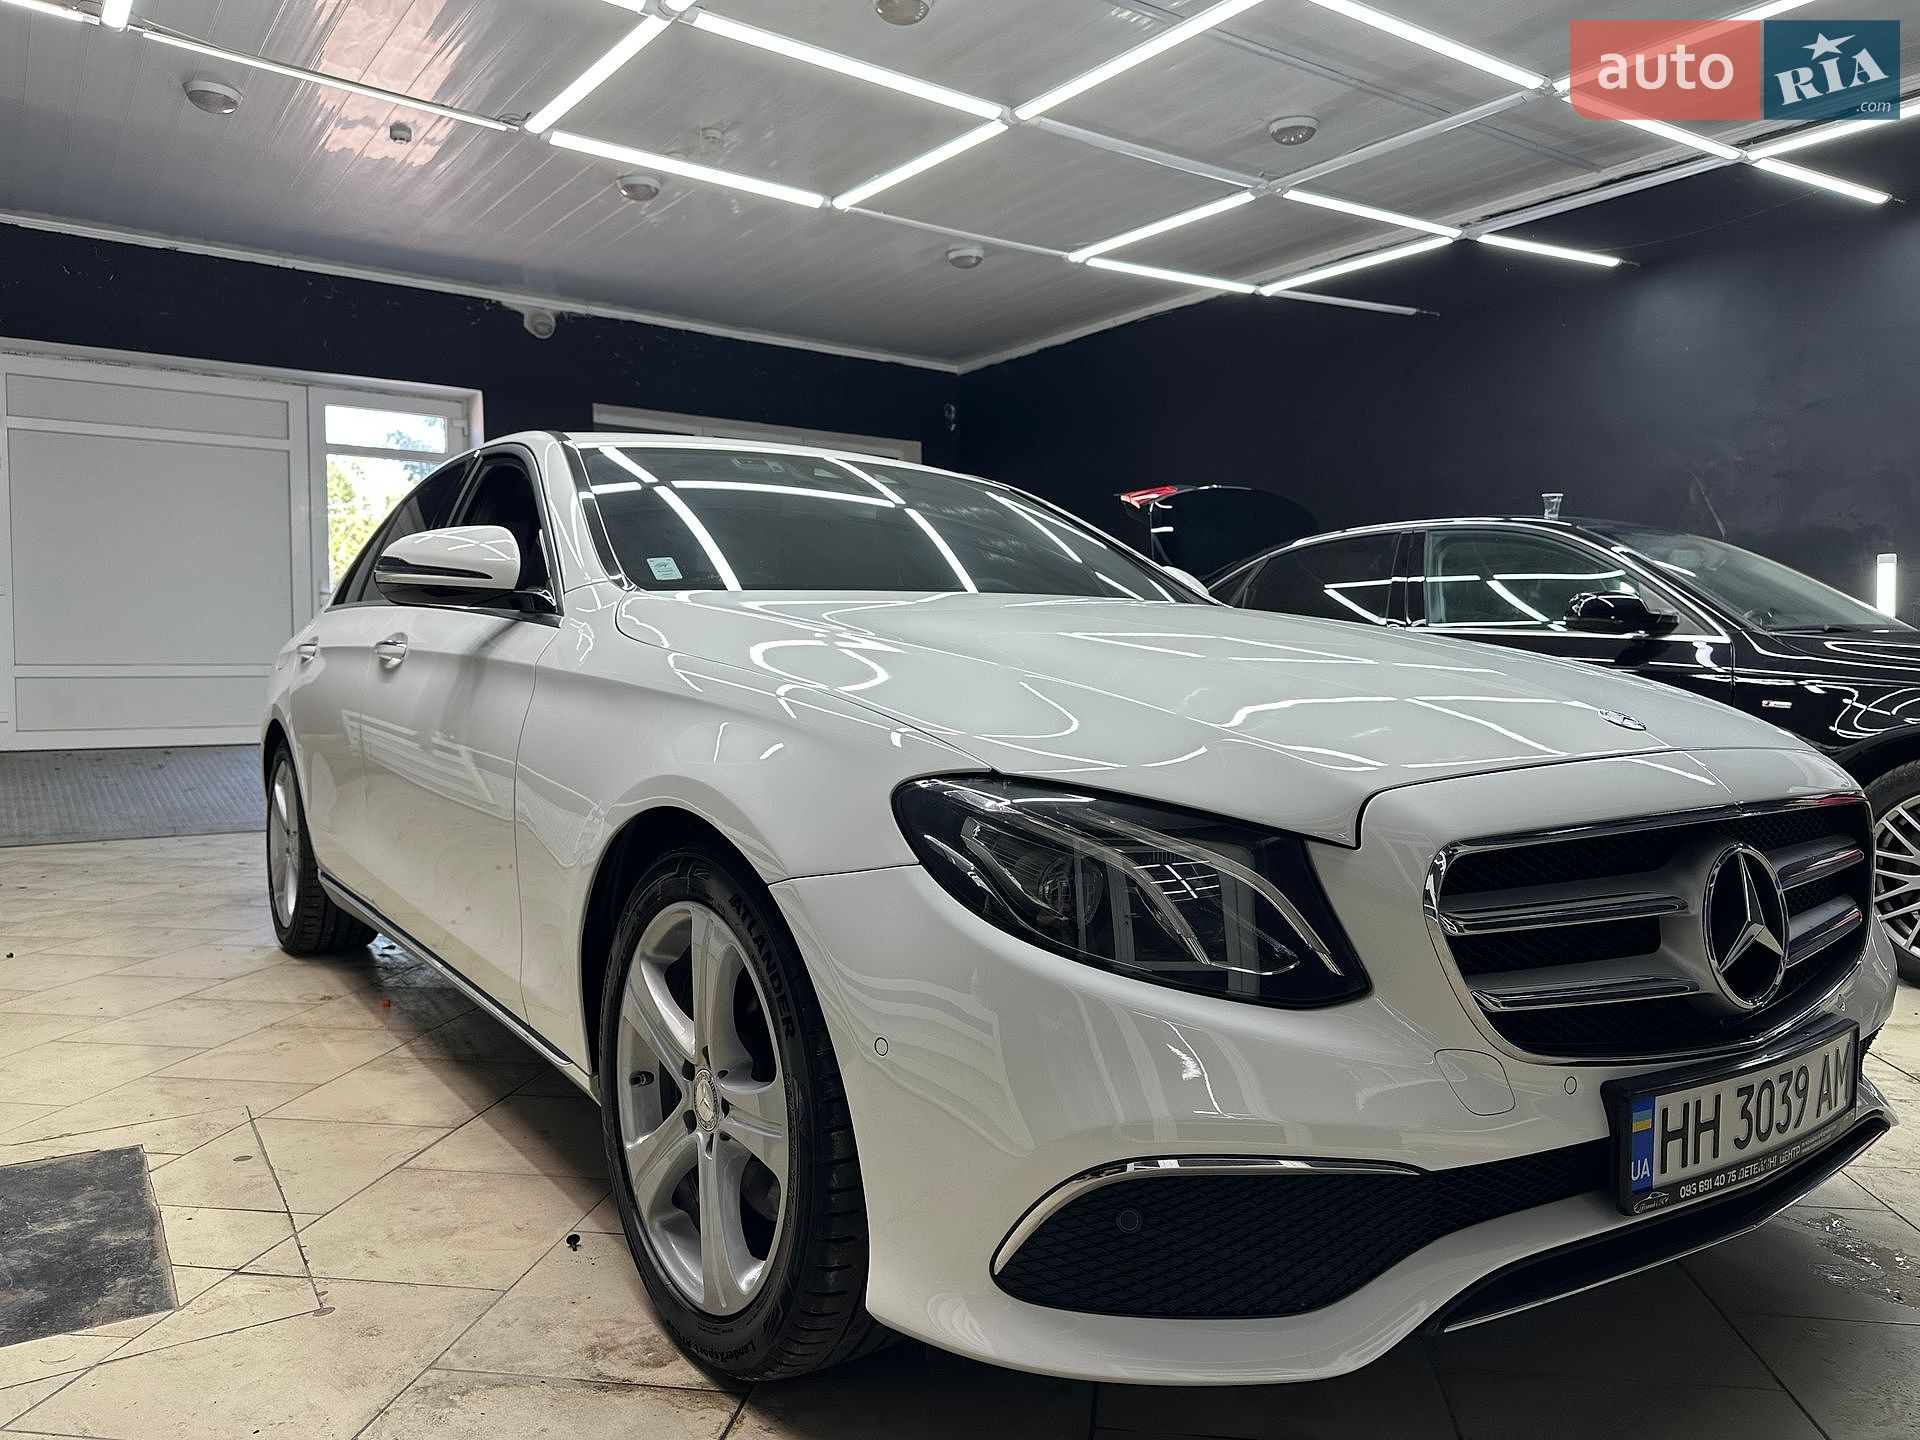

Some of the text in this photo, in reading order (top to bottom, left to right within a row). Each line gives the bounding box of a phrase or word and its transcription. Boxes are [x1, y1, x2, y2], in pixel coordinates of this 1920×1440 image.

[729, 893, 796, 1041] ATLANDER
[1660, 1041, 1851, 1174] HH 3039 AM
[1631, 1158, 1650, 1181] UA
[1679, 1182, 1697, 1198] 093
[1699, 1179, 1713, 1193] 691
[1714, 1174, 1726, 1187] 40
[1727, 1169, 1737, 1183] 75
